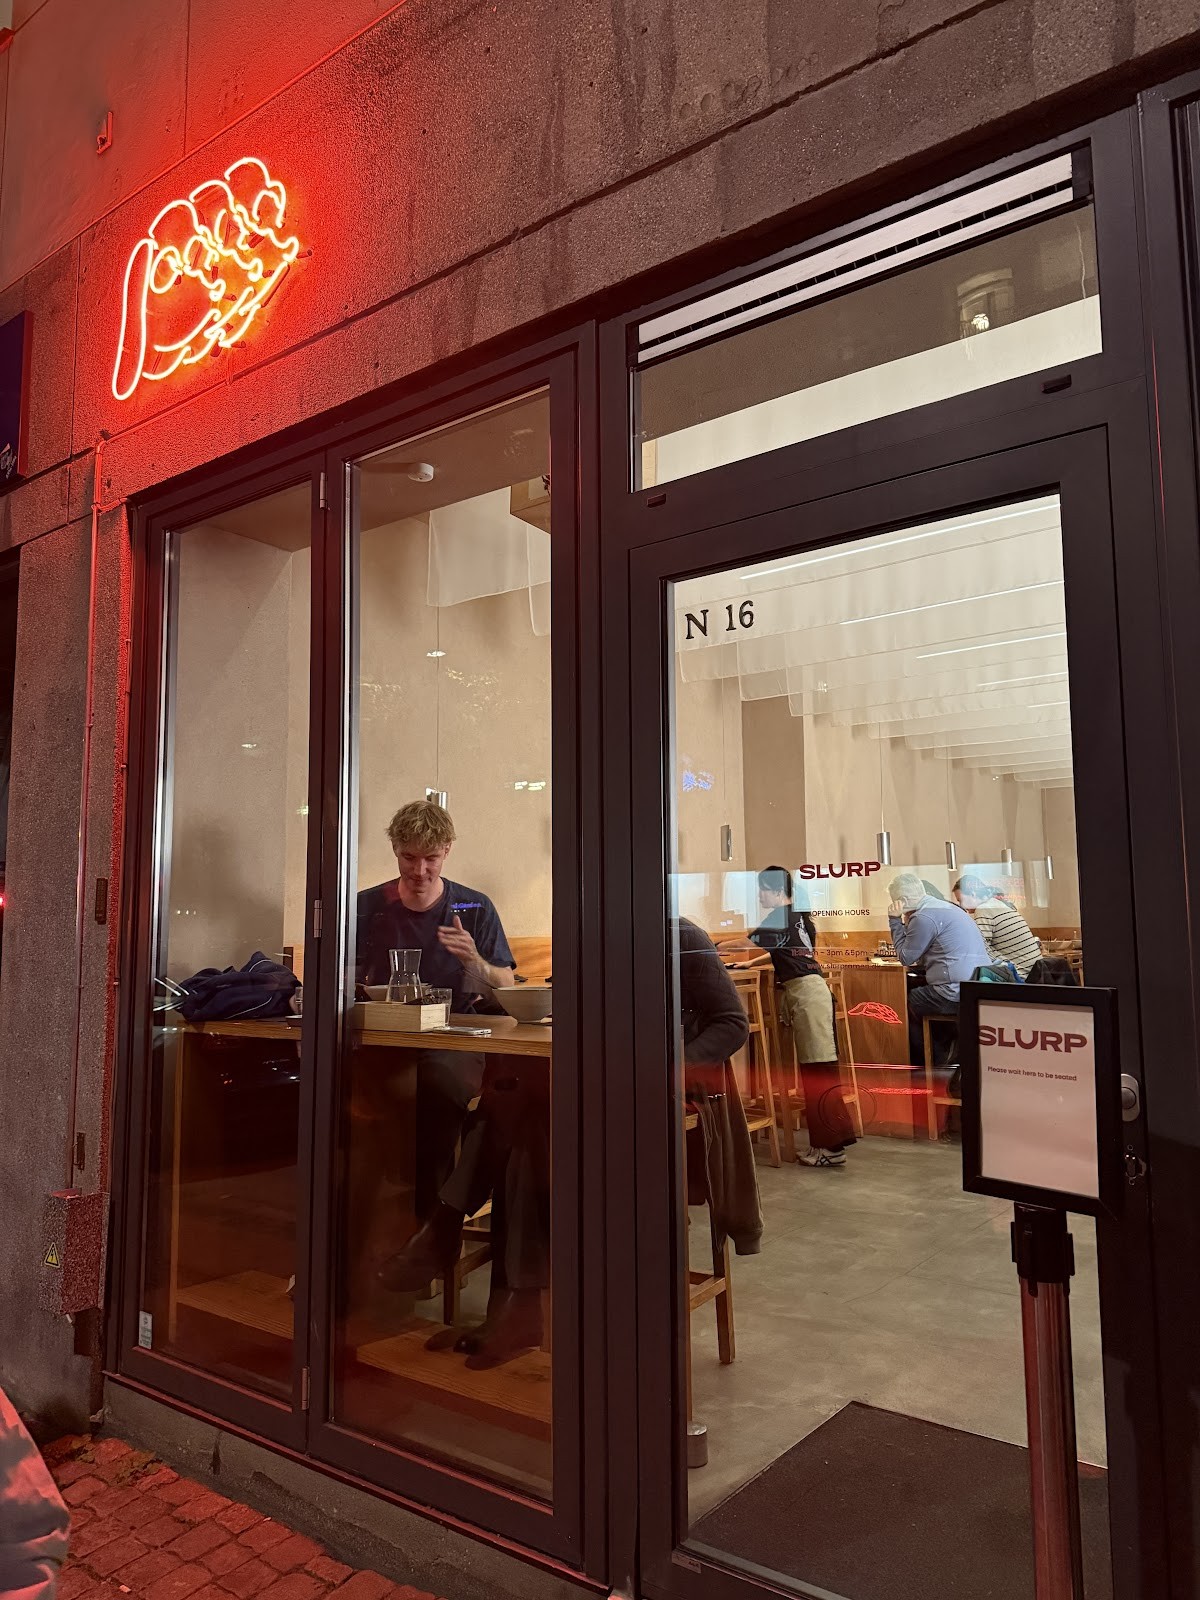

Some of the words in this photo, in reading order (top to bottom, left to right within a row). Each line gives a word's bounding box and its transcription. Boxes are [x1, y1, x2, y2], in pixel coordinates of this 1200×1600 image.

[685, 609, 709, 639] N
[726, 600, 754, 631] 16
[800, 862, 881, 879] SLURP
[826, 949, 844, 957] 3pm
[979, 1025, 1087, 1053] SLURP
[988, 1066, 1007, 1074] Please
